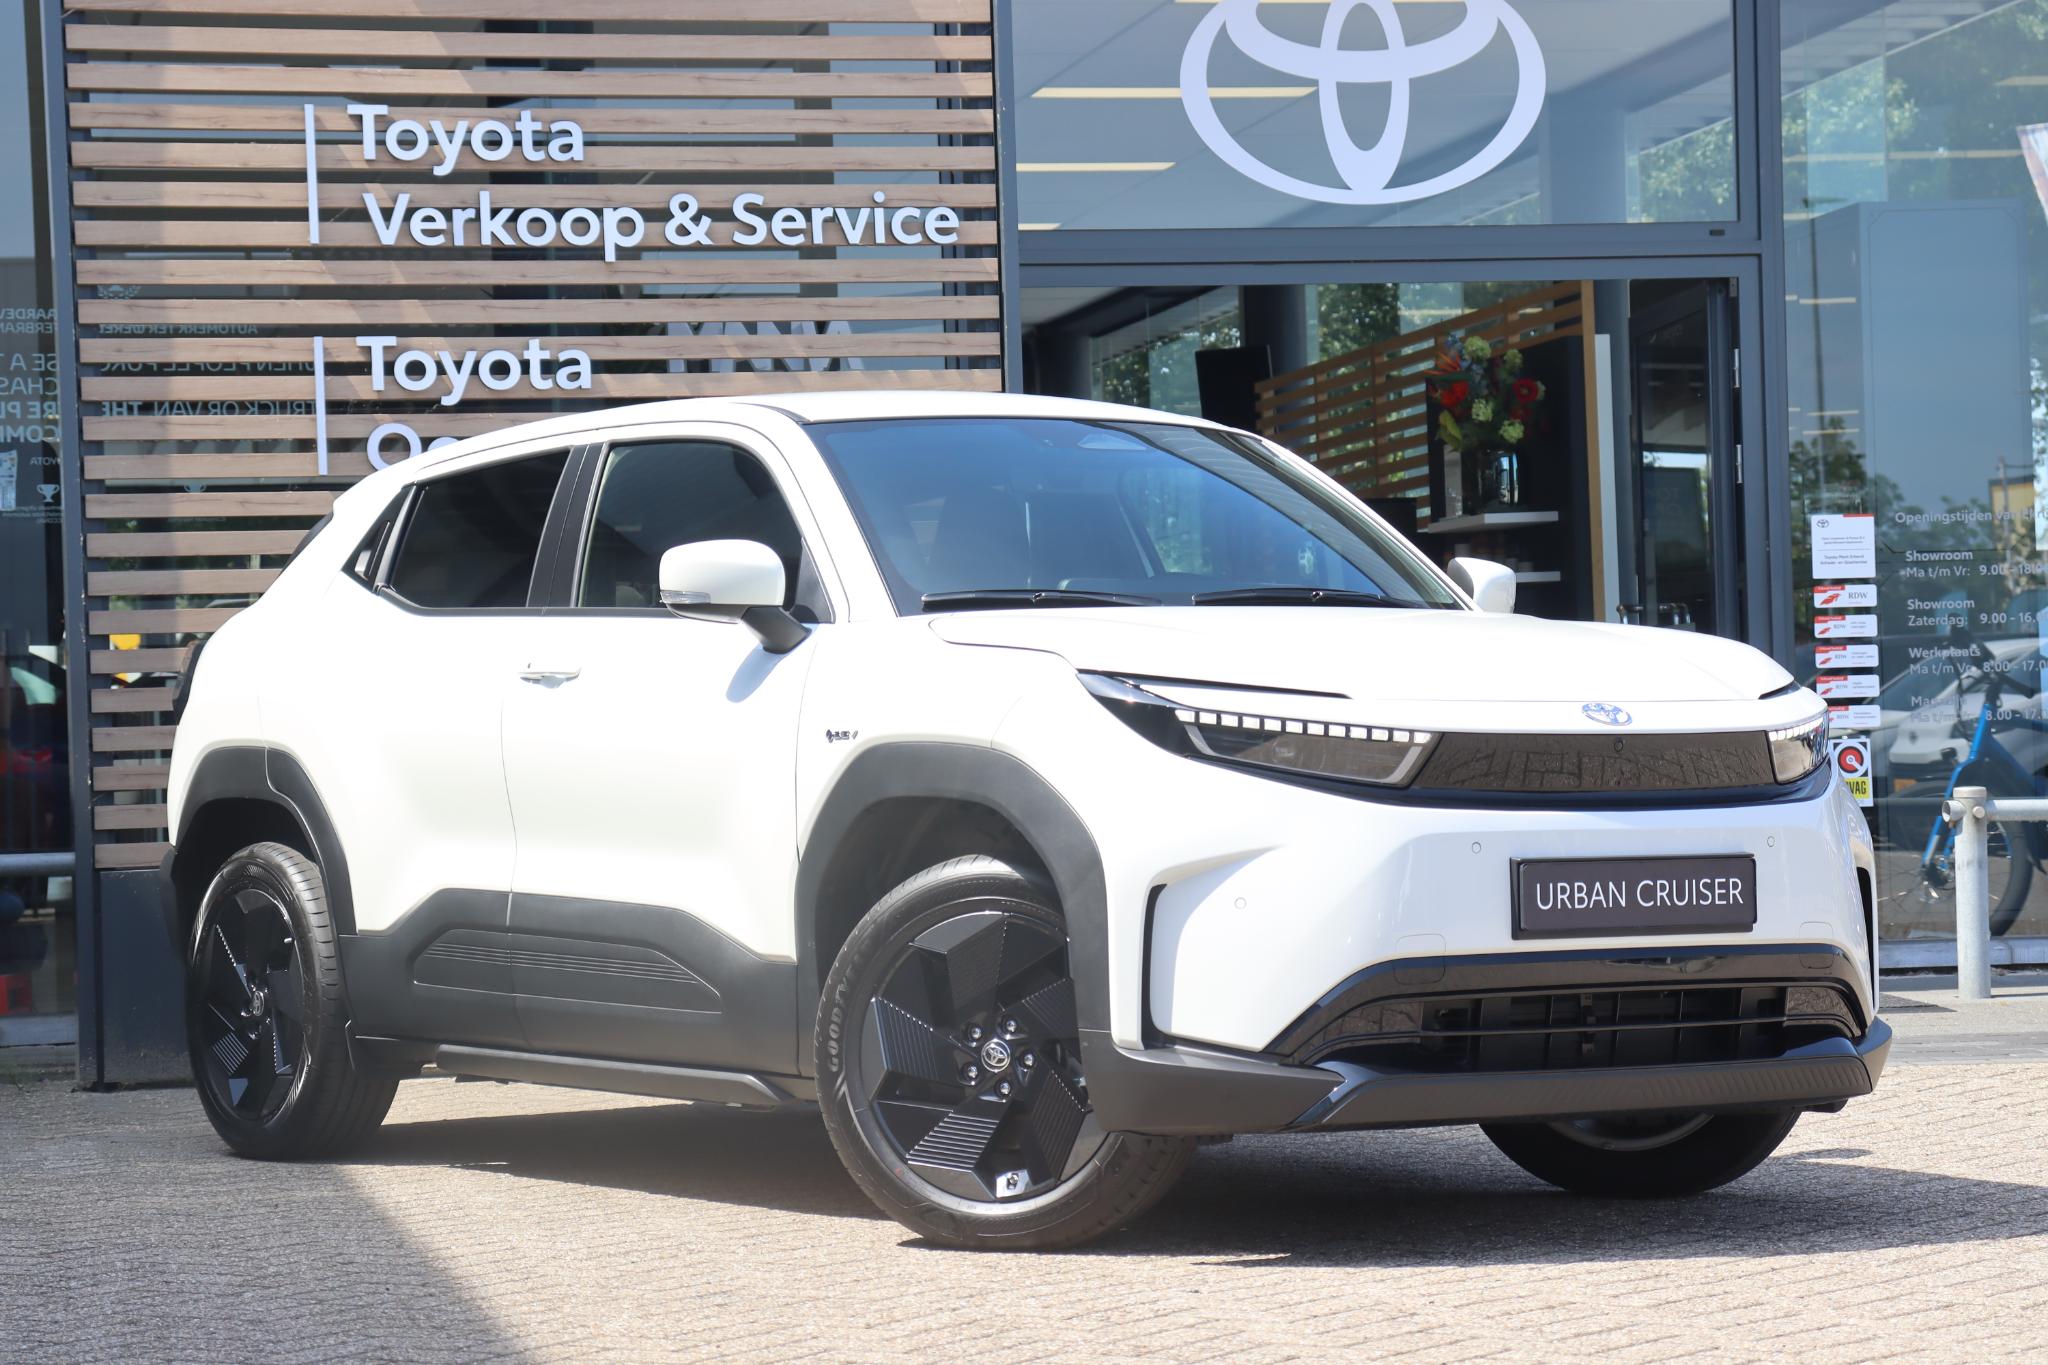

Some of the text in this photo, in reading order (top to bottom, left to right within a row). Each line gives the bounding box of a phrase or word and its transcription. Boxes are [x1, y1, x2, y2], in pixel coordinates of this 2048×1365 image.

[347, 104, 584, 177] Toyota
[361, 190, 960, 262] Verkoop & Service
[356, 336, 592, 406] Toyota
[1895, 510, 1992, 524] Openingstijden
[1905, 550, 1974, 562] Showroom
[1906, 567, 1925, 577] Ma
[1928, 566, 1950, 579] t/m
[1953, 566, 1970, 577] Vr:
[1848, 591, 1868, 600] RDW
[1907, 599, 1975, 610] Showroom
[1908, 615, 1968, 627] Zaterdag:
[1979, 612, 2007, 623] 9.00
[1909, 647, 1981, 659] Werkplaats
[1910, 664, 1928, 675] Ma
[1931, 663, 1954, 676] t/m
[1985, 709, 2011, 721] 8.00
[1536, 878, 1743, 910] URBAN CRUISER
